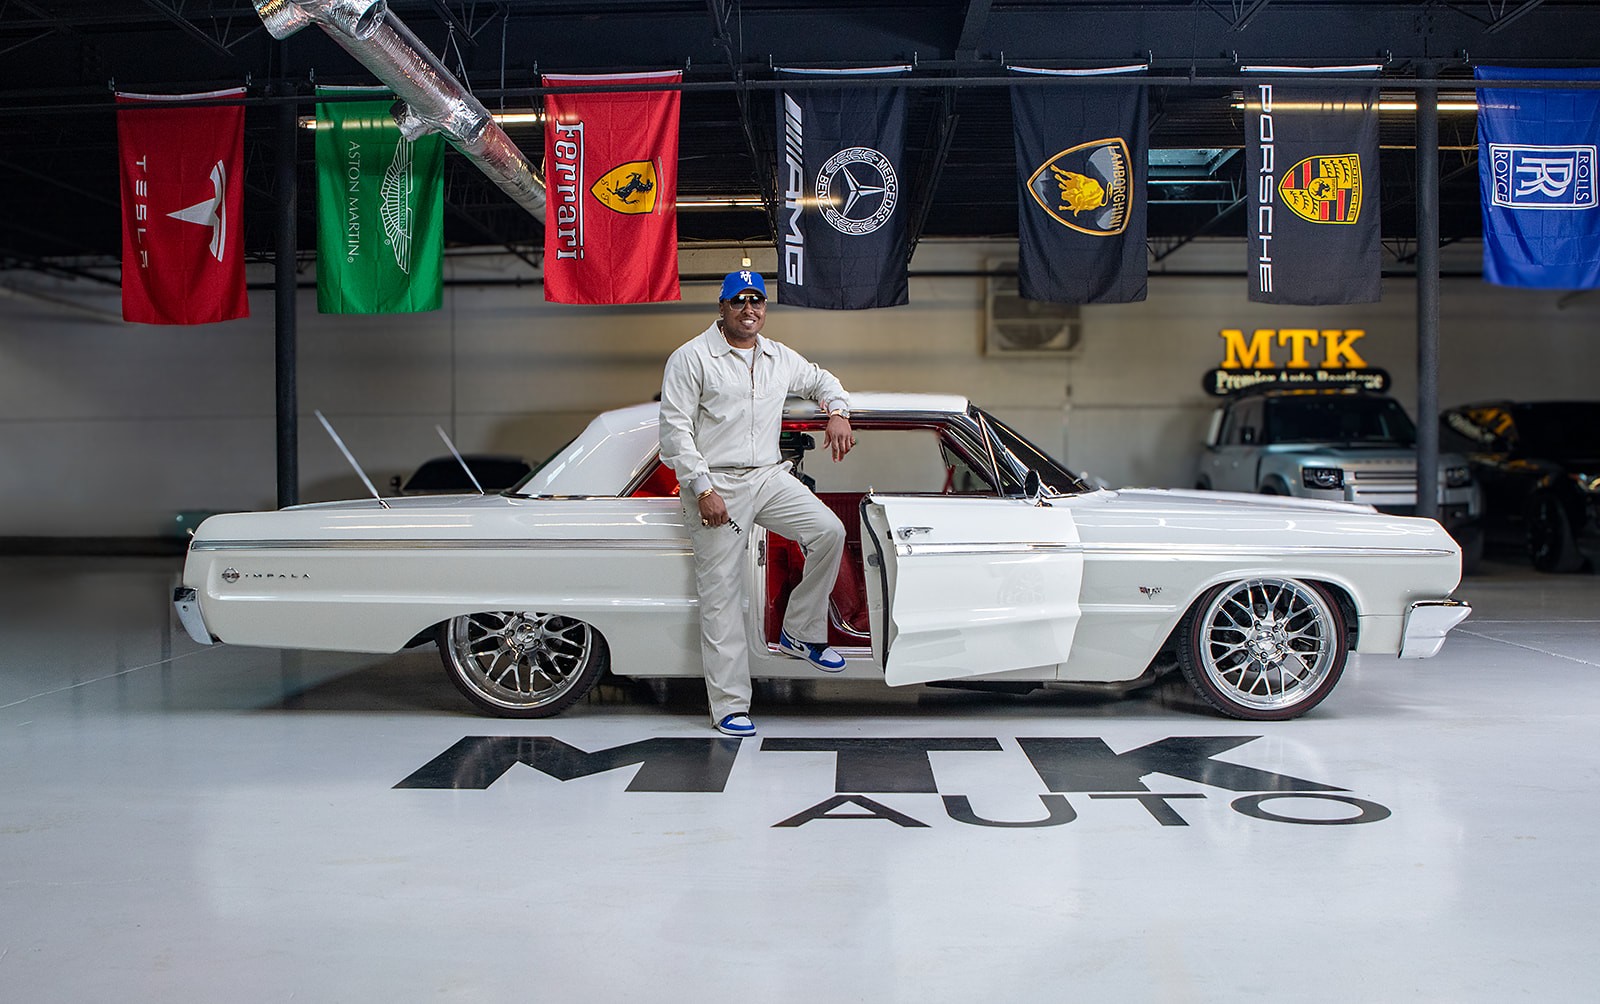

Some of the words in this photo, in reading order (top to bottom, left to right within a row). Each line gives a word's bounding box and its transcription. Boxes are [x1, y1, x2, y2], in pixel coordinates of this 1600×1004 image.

[348, 140, 360, 192] ASTON
[554, 119, 585, 260] Ferrari
[876, 158, 896, 222] MERCEDES
[1107, 145, 1127, 229] LAMBORGHINI
[1258, 84, 1274, 293] PORSCHE
[1494, 151, 1509, 202] ROYCE
[1575, 155, 1590, 201] ROLLS
[135, 154, 149, 269] TESLA
[348, 197, 360, 256] MARTIN
[1218, 328, 1369, 369] MTK
[391, 735, 1354, 793] MTK
[770, 792, 1392, 828] AUTO
